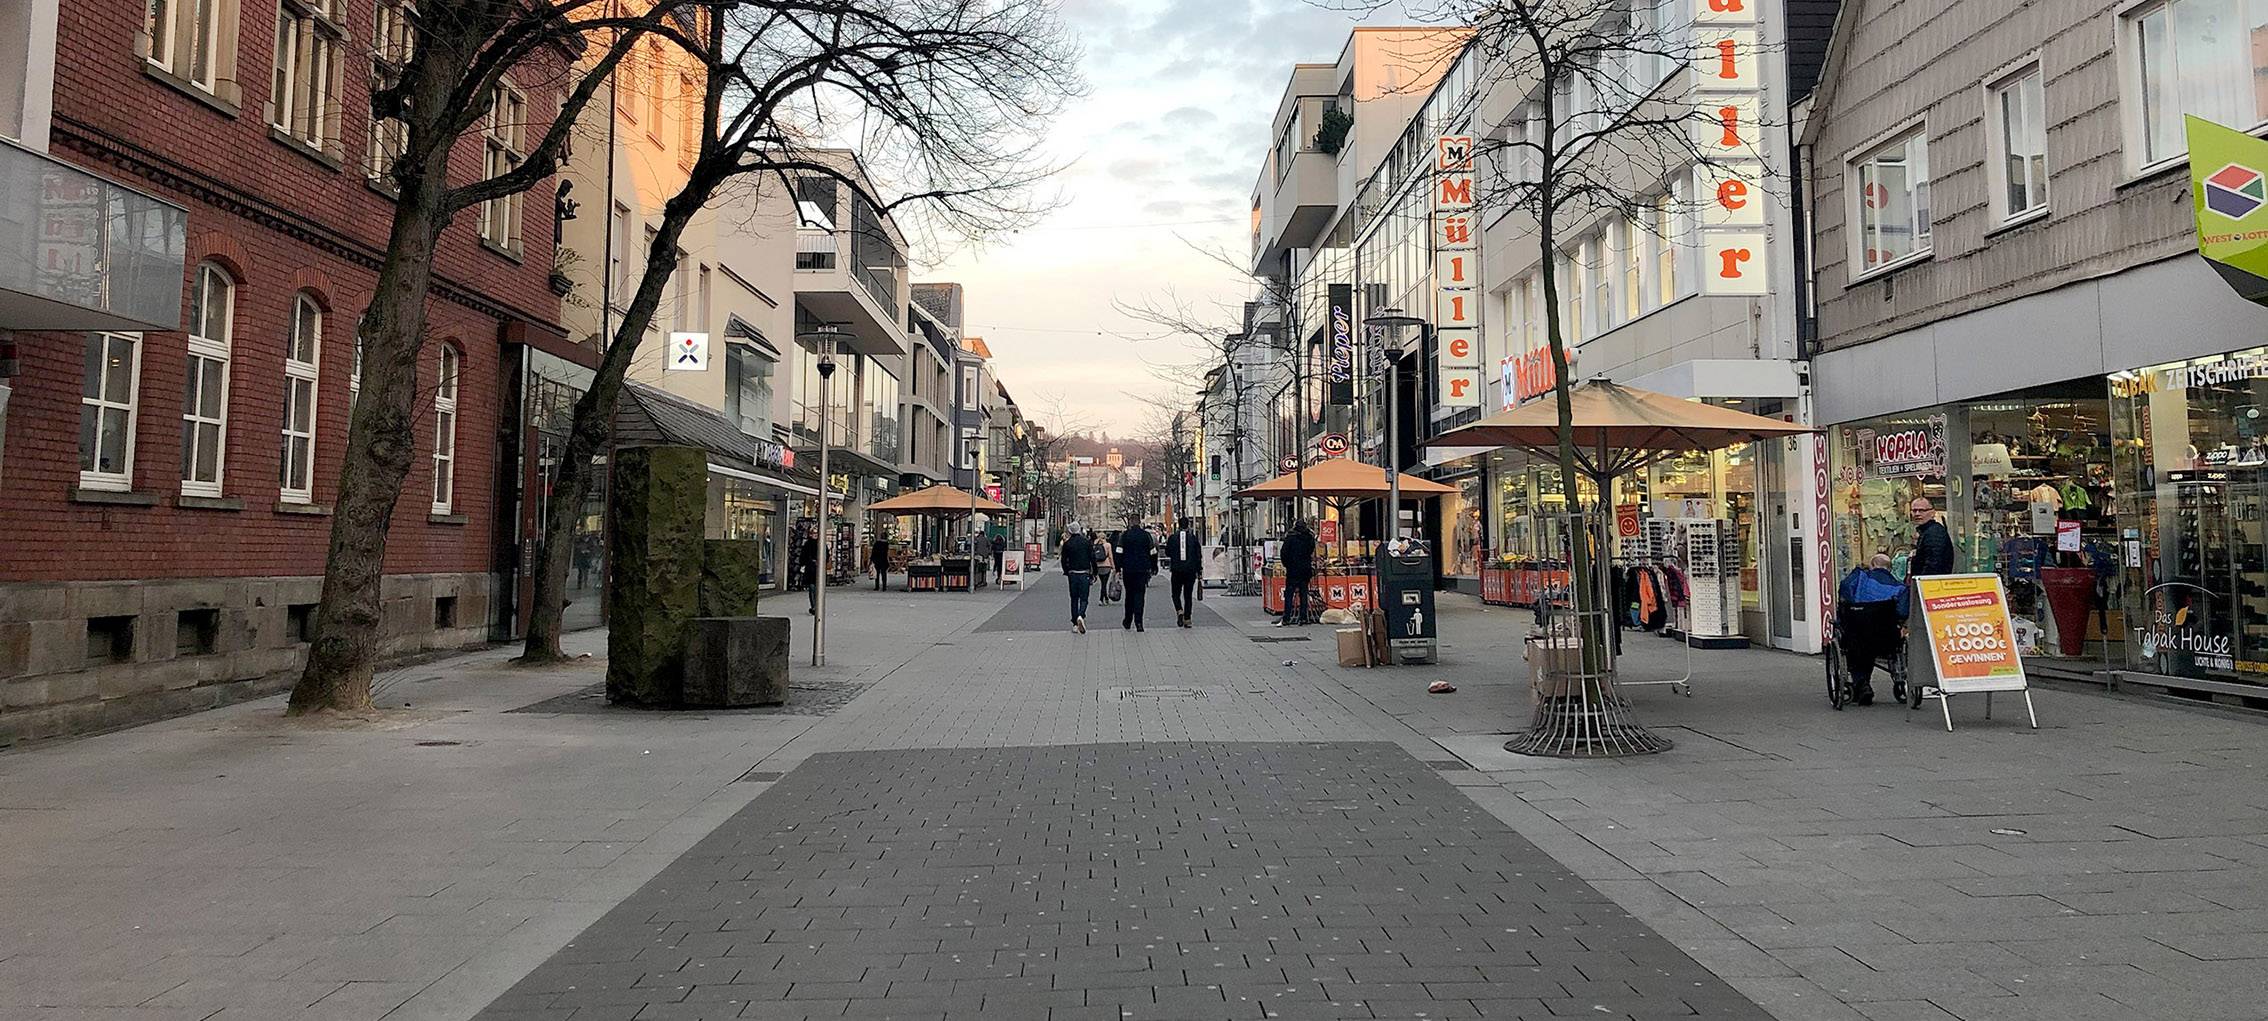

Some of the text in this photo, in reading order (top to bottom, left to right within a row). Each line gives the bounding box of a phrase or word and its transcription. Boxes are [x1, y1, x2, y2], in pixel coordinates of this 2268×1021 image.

[1330, 305, 1353, 384] Pieper
[2112, 373, 2158, 398] TABAK
[1787, 436, 1797, 451] 36
[1877, 430, 1928, 463] HOPPLA
[2206, 449, 2228, 460] zippo
[1814, 435, 1834, 640] HOPPLA
[2155, 610, 2172, 624] Das
[1944, 623, 1994, 637] 1.000
[2134, 624, 2230, 654] Tabak House
